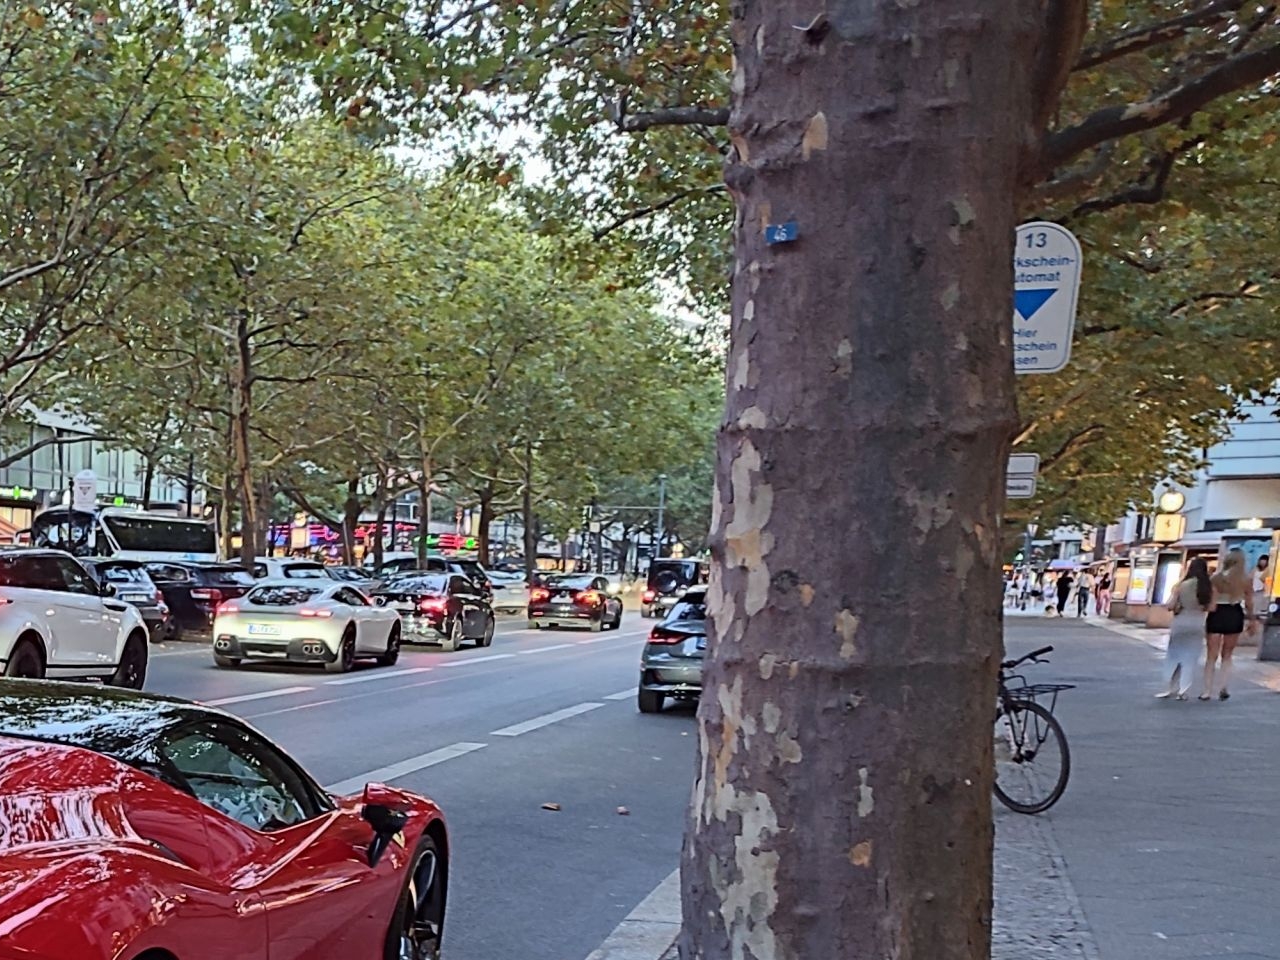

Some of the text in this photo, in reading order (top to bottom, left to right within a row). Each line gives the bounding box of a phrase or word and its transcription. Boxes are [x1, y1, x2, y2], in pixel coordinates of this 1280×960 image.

[1024, 232, 1048, 249] 13
[1015, 256, 1075, 267] kschein-
[1015, 341, 1057, 352] schein
[1015, 356, 1038, 365] sen
